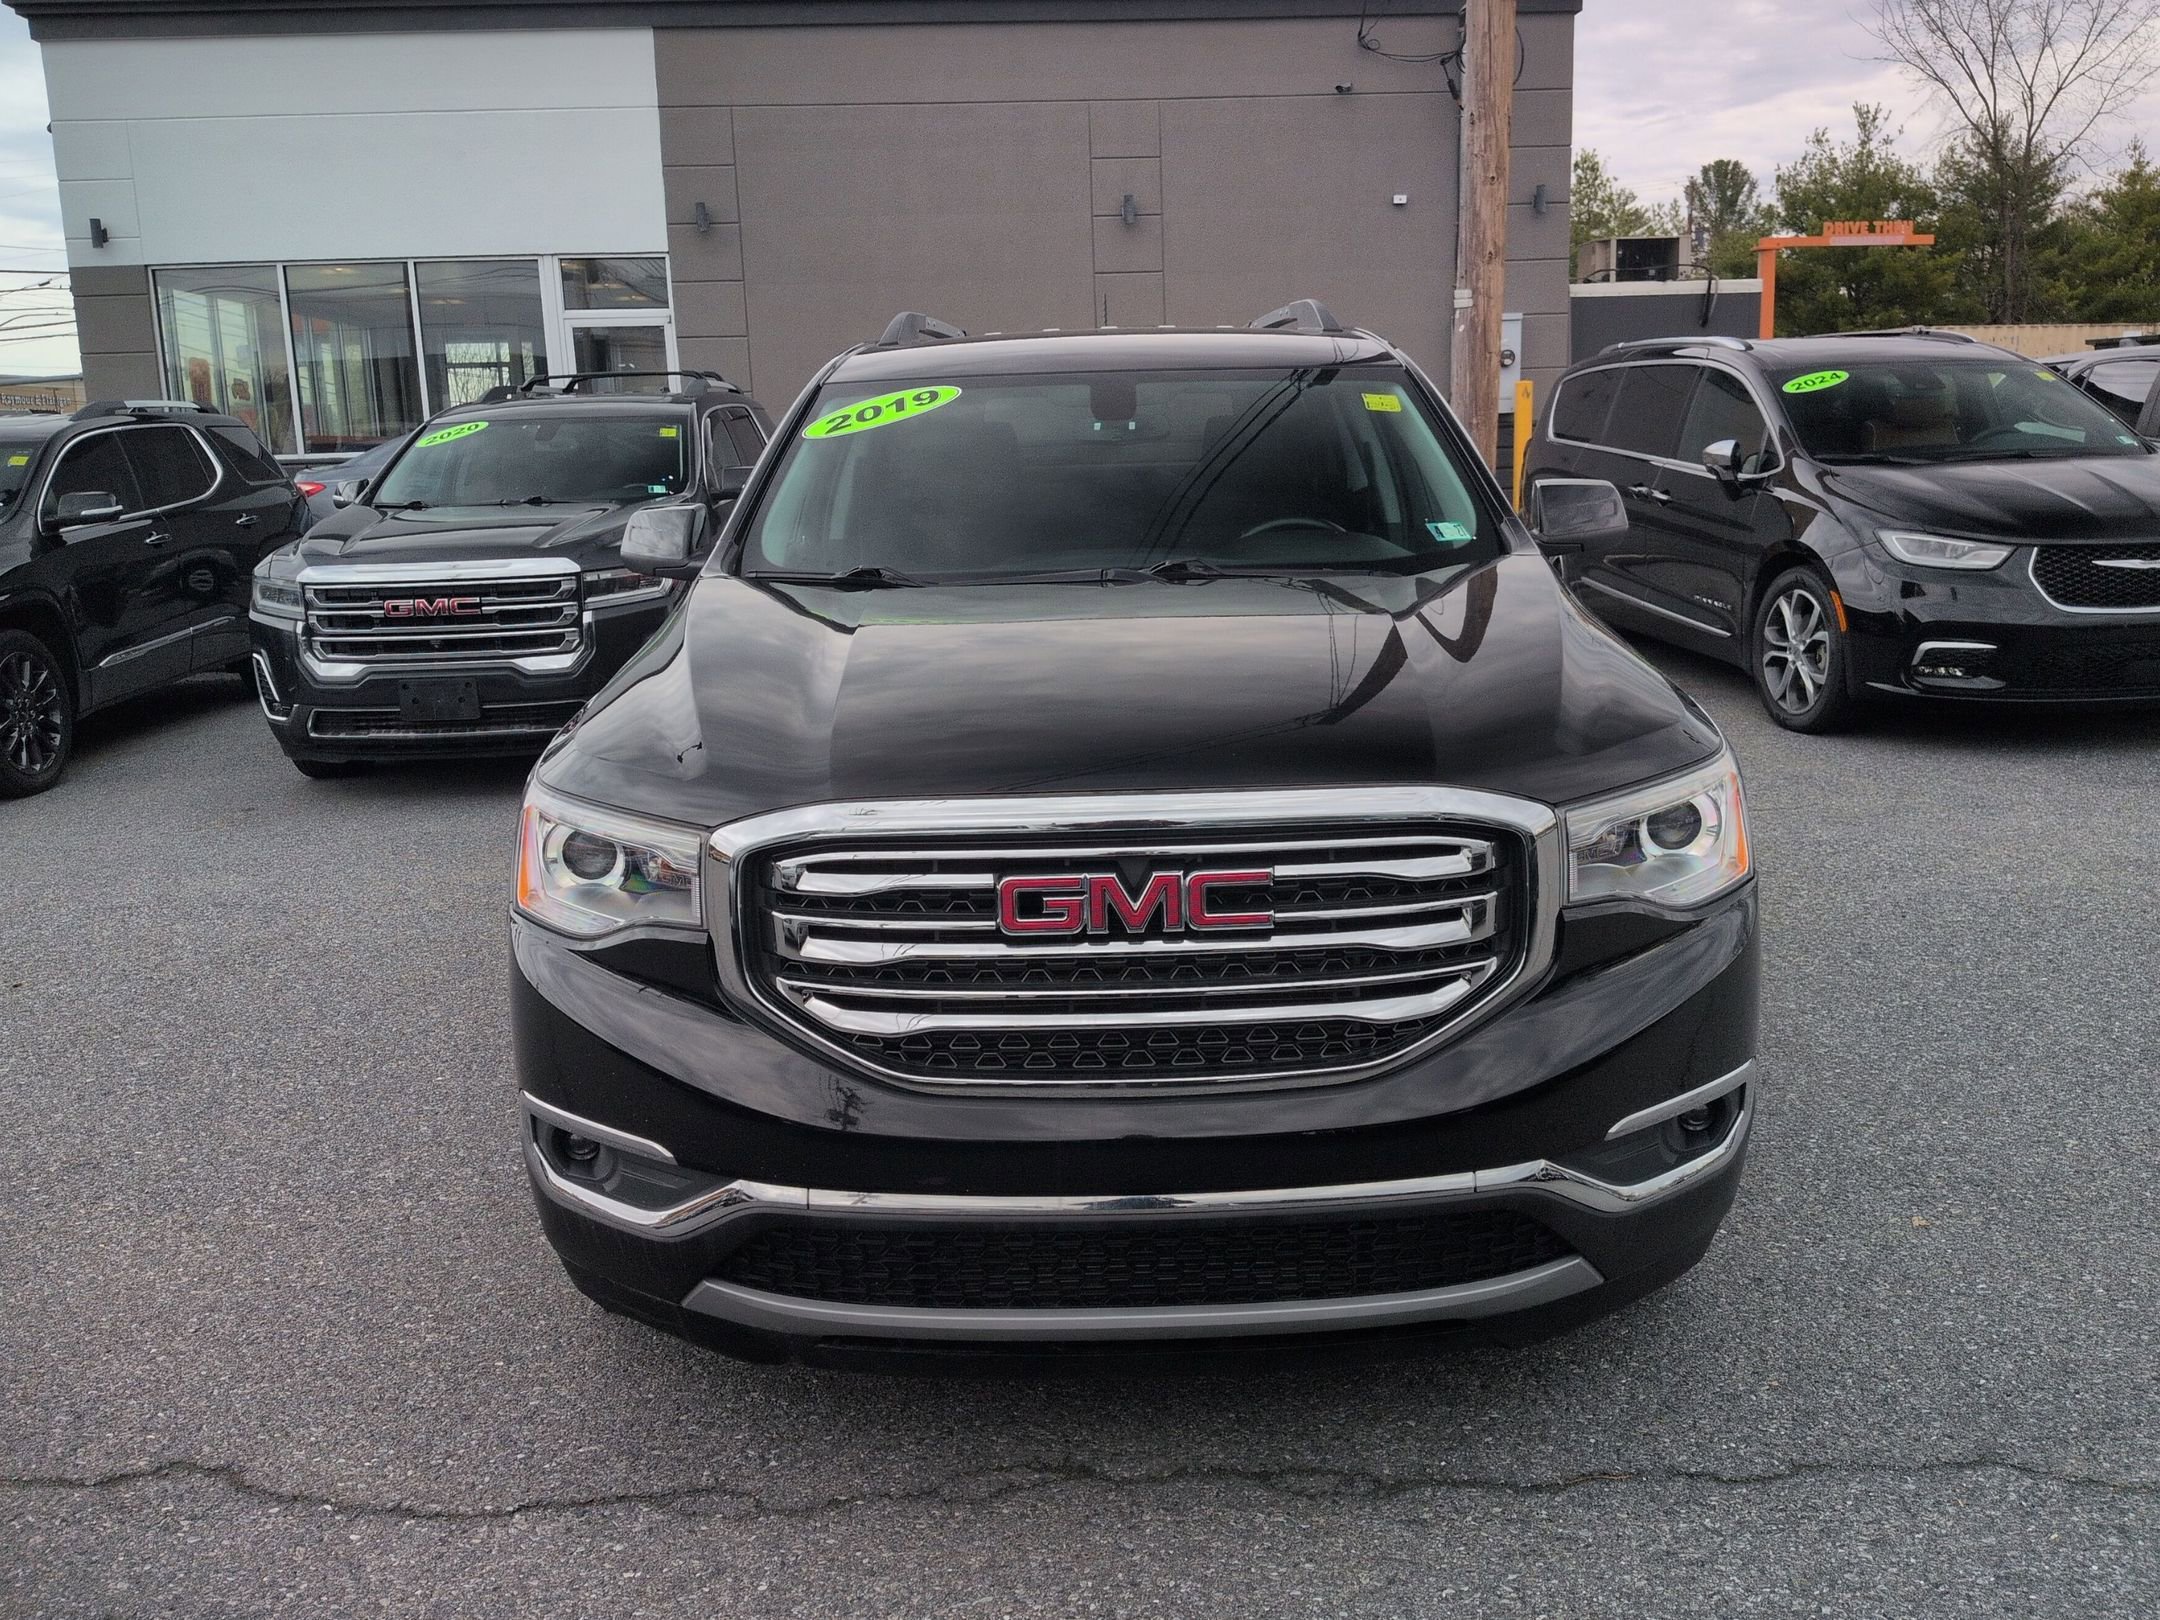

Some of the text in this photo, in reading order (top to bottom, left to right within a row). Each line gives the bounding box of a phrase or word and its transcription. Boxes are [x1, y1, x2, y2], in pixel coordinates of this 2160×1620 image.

[1823, 220, 1914, 235] DRIVE THRU
[1790, 372, 1842, 391] 2024
[824, 390, 939, 434] 2019
[424, 423, 480, 445] 2020
[384, 597, 481, 617] GMC
[998, 869, 1274, 936] GMC
